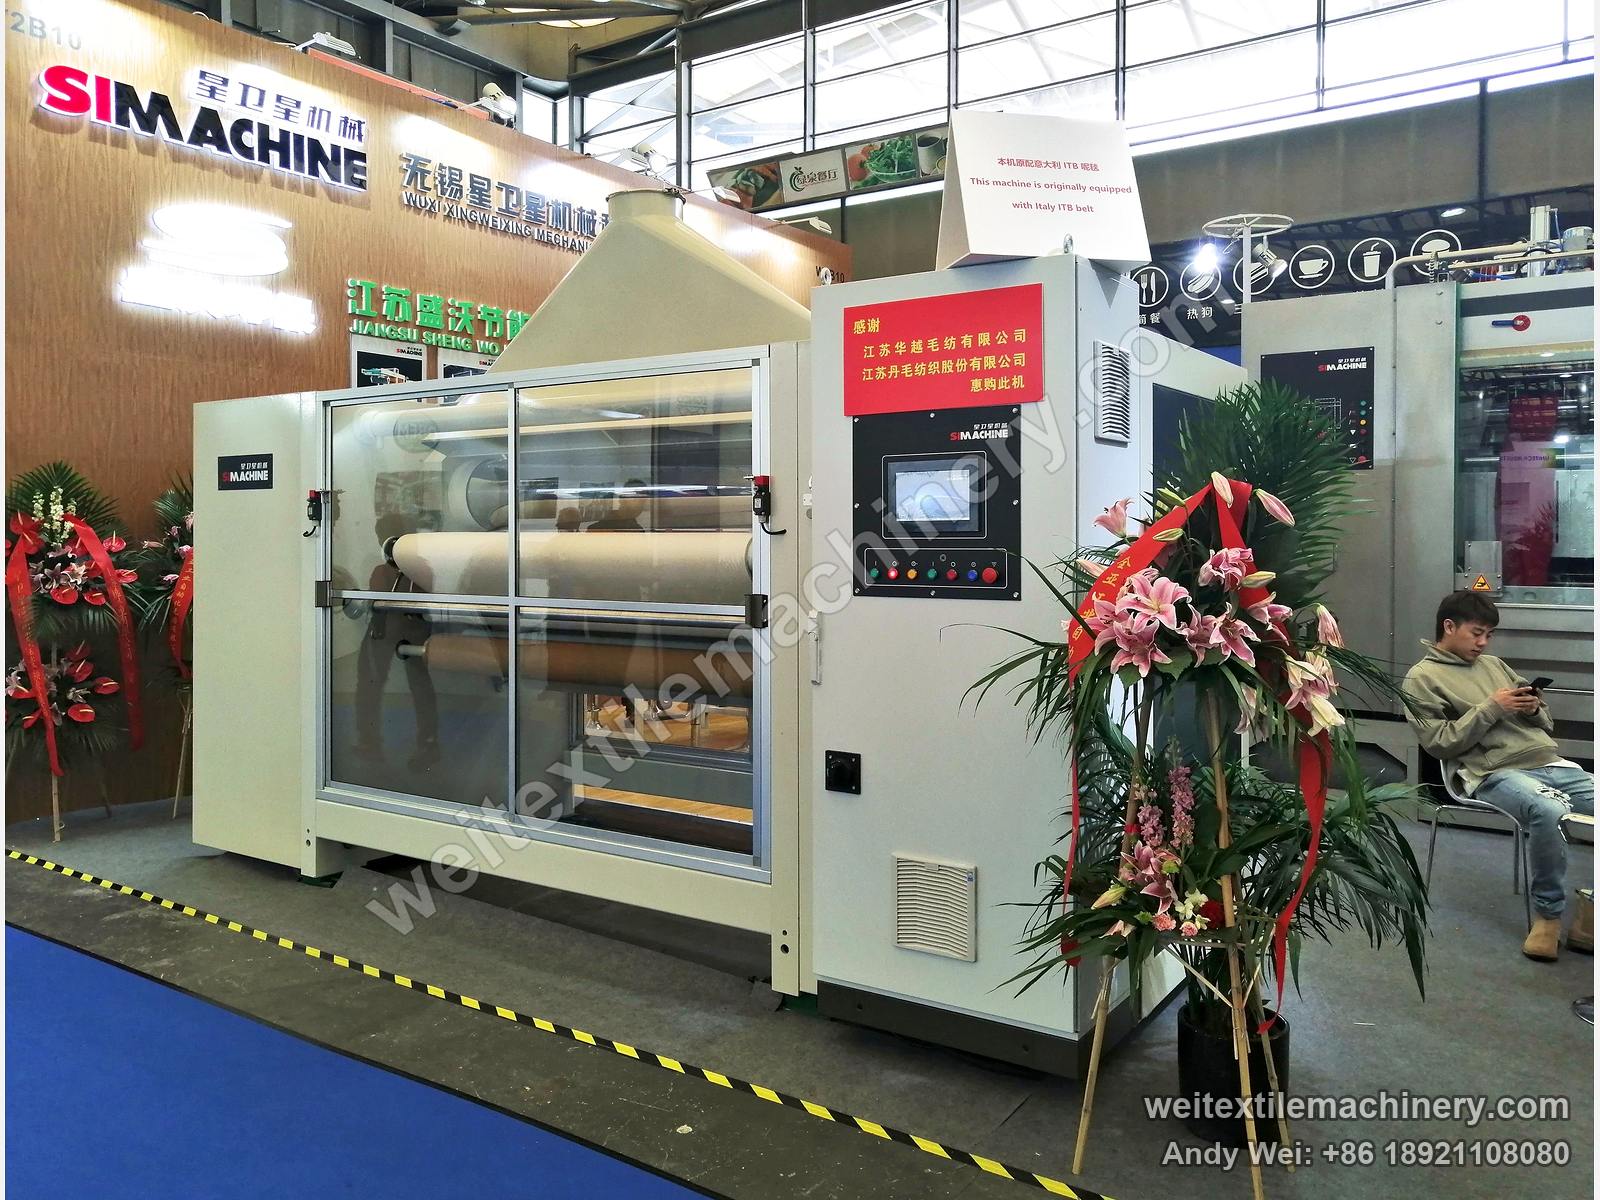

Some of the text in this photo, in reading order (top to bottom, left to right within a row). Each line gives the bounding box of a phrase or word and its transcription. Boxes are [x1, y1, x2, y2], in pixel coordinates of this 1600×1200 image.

[5, 8, 82, 50] 2B10
[195, 69, 366, 143] 星卫星机械
[42, 65, 367, 190] SIMACHINE
[997, 157, 1061, 170] 本机原配意大利
[1064, 162, 1079, 170] ITB
[970, 177, 1132, 194] This machine is originally equipped
[1012, 201, 1095, 213] with Italy ITB belt
[403, 191, 592, 253] WUXI XINGWEIXING MECHANI
[1187, 306, 1213, 320] 热狗
[349, 318, 420, 343] JIANGSU
[422, 331, 473, 352] SHENG
[853, 318, 881, 335] 感谢
[863, 329, 1027, 359] 江苏华越毛纺有限公司
[862, 352, 1026, 381] 江苏丹毛纺织股份有限公司
[1318, 362, 1367, 372] SIMACHINE
[970, 375, 1026, 392] 惠购此机
[950, 429, 1009, 441] SIMACHINE
[223, 469, 269, 483] SIMACHINE
